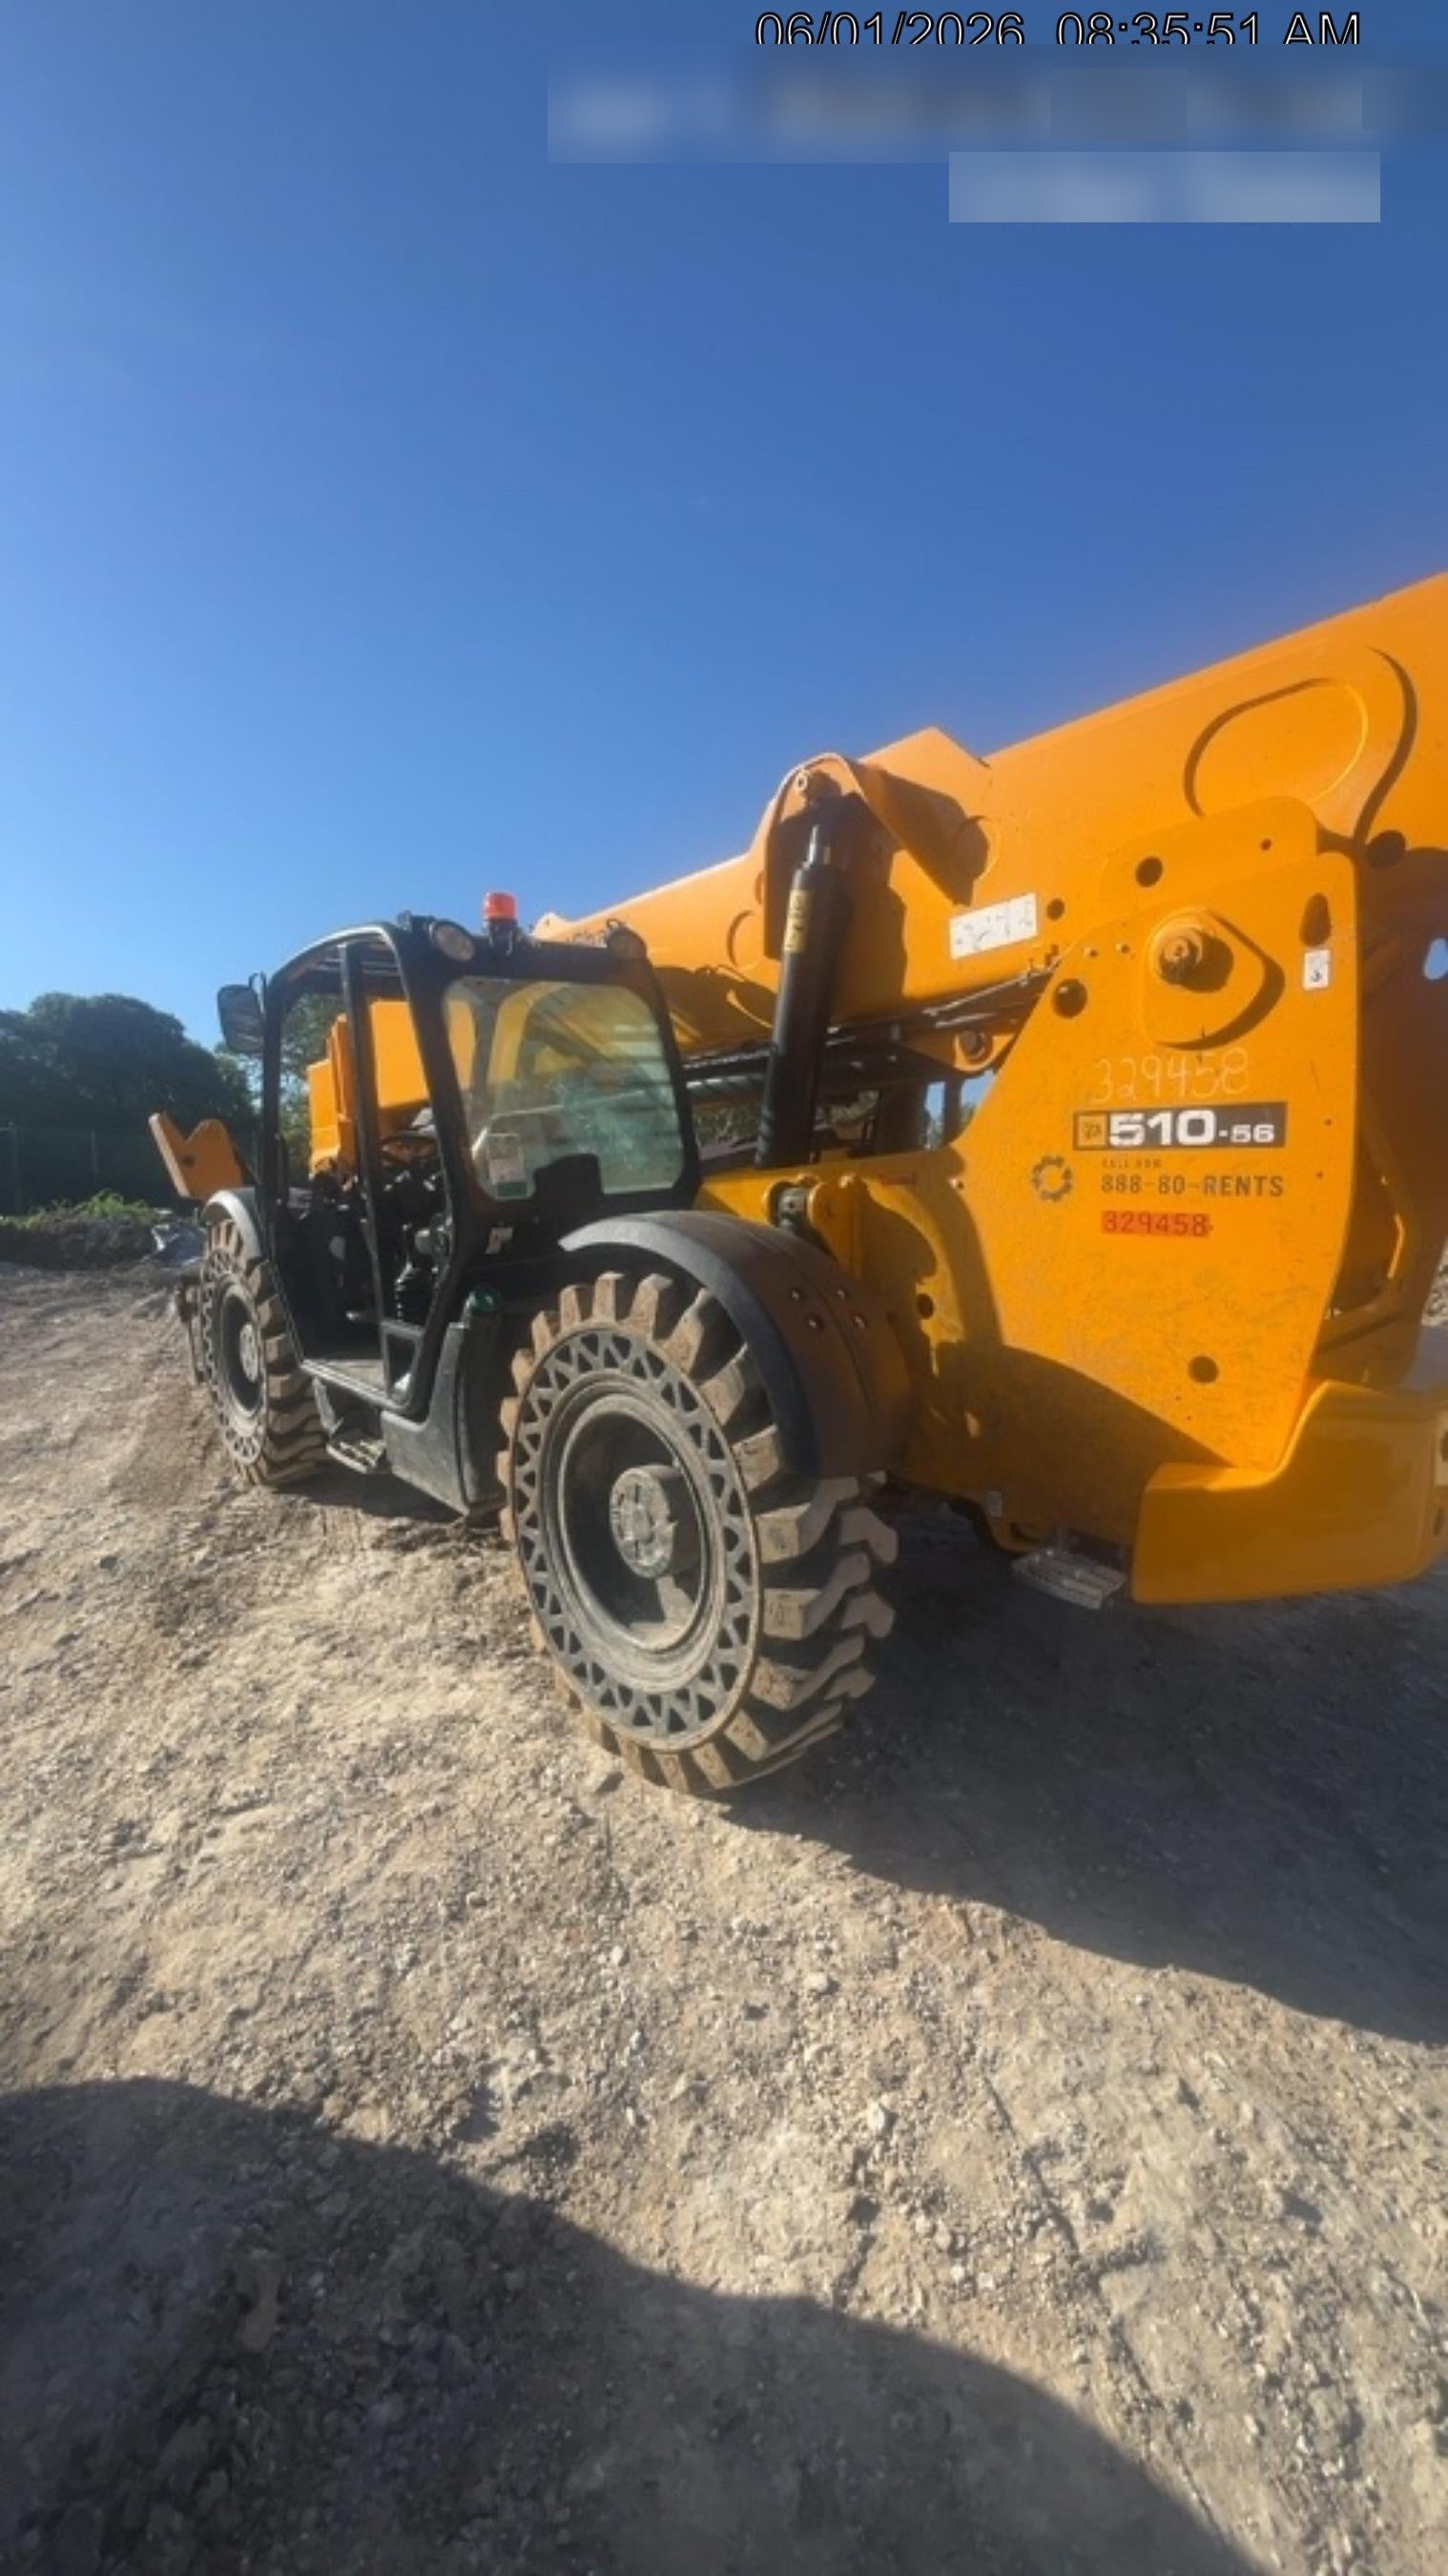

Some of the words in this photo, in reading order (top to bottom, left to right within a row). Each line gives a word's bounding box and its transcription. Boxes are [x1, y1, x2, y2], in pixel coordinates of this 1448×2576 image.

[1089, 1047, 1249, 1103] 329458
[1108, 1109, 1275, 1146] 510-56
[1104, 1211, 1209, 1236] 329458
